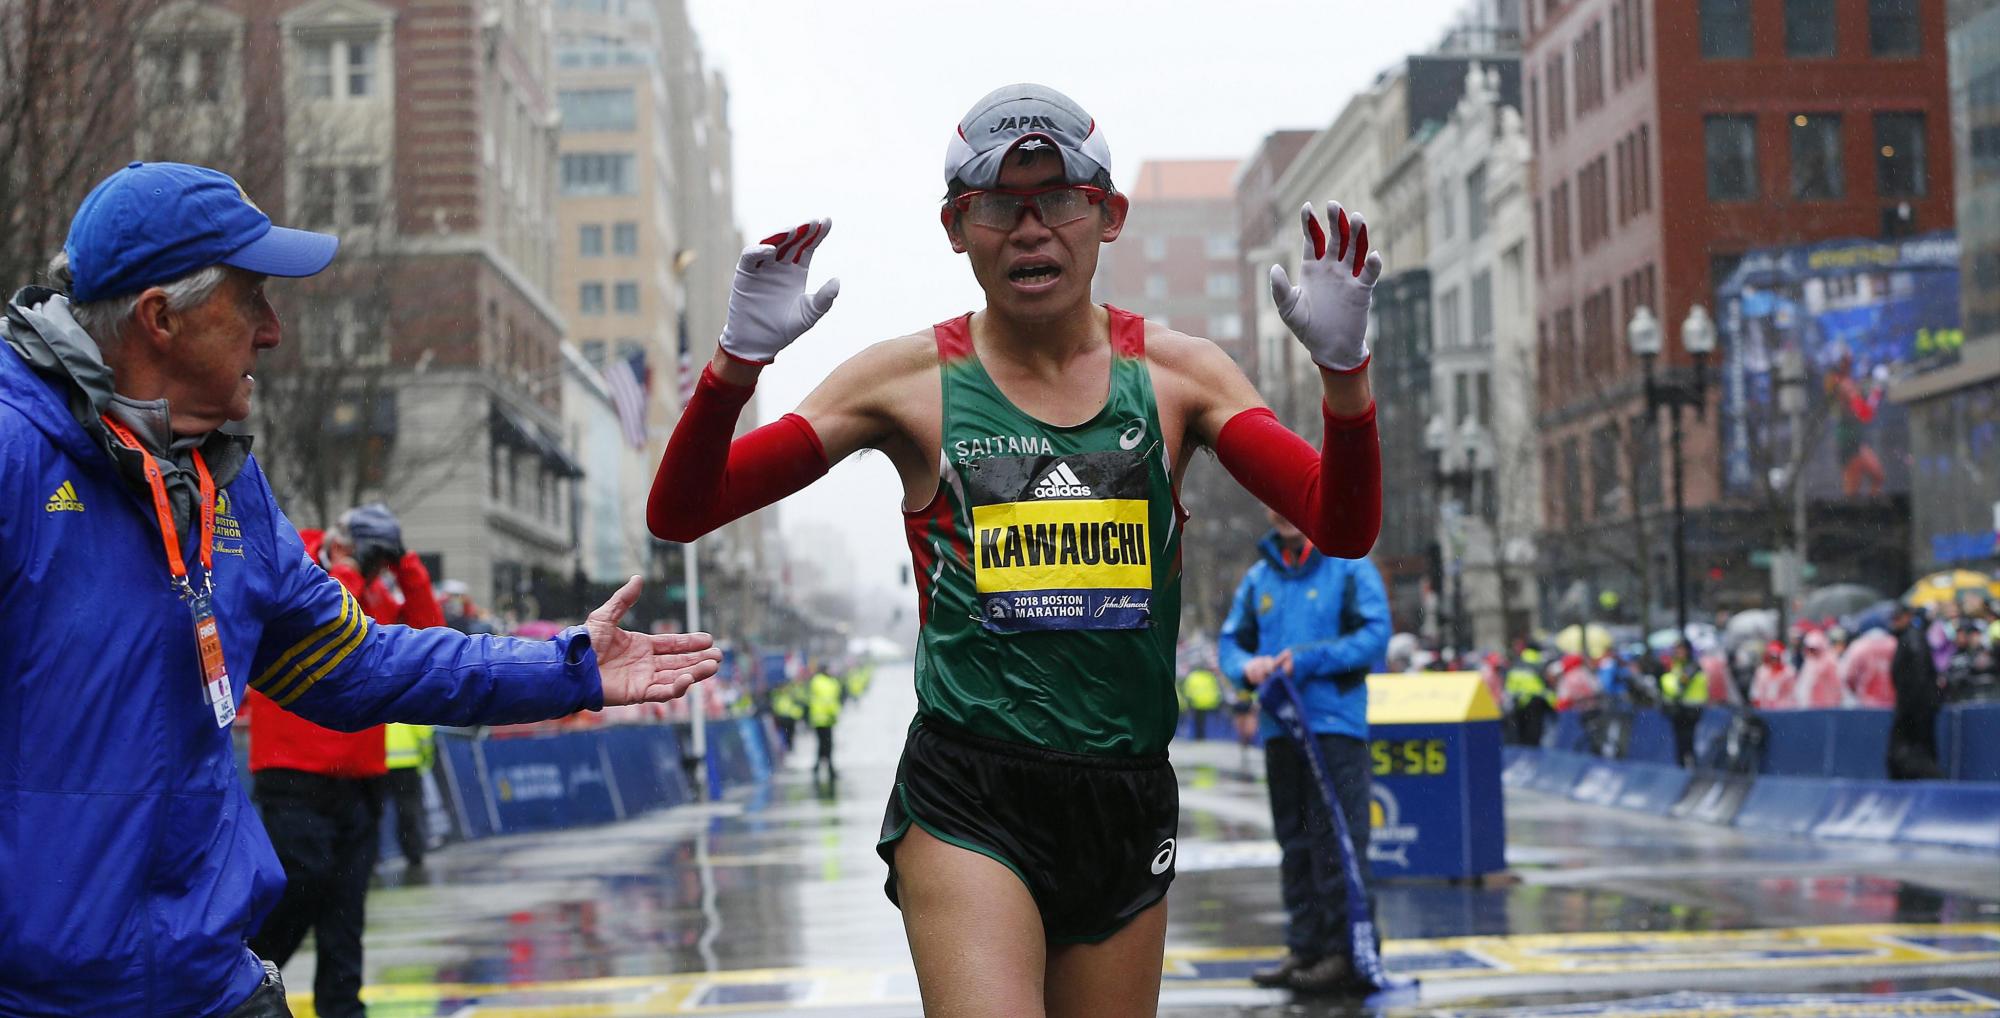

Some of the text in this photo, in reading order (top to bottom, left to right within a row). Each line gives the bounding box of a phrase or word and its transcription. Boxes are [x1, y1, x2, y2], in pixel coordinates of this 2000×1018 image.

[990, 115, 1064, 134] JAPAN
[955, 435, 1054, 457] SAITAMA
[1034, 484, 1092, 498] adidas
[45, 499, 85, 513] adidas
[215, 517, 240, 529] BOSTON
[212, 525, 242, 538] RATHON
[980, 521, 1147, 569] KAWAUCHI
[1014, 596, 1039, 608] 2018
[1042, 595, 1083, 606] BOSTON
[1094, 595, 1150, 618] John Hancock
[1015, 606, 1084, 619] MARATHON
